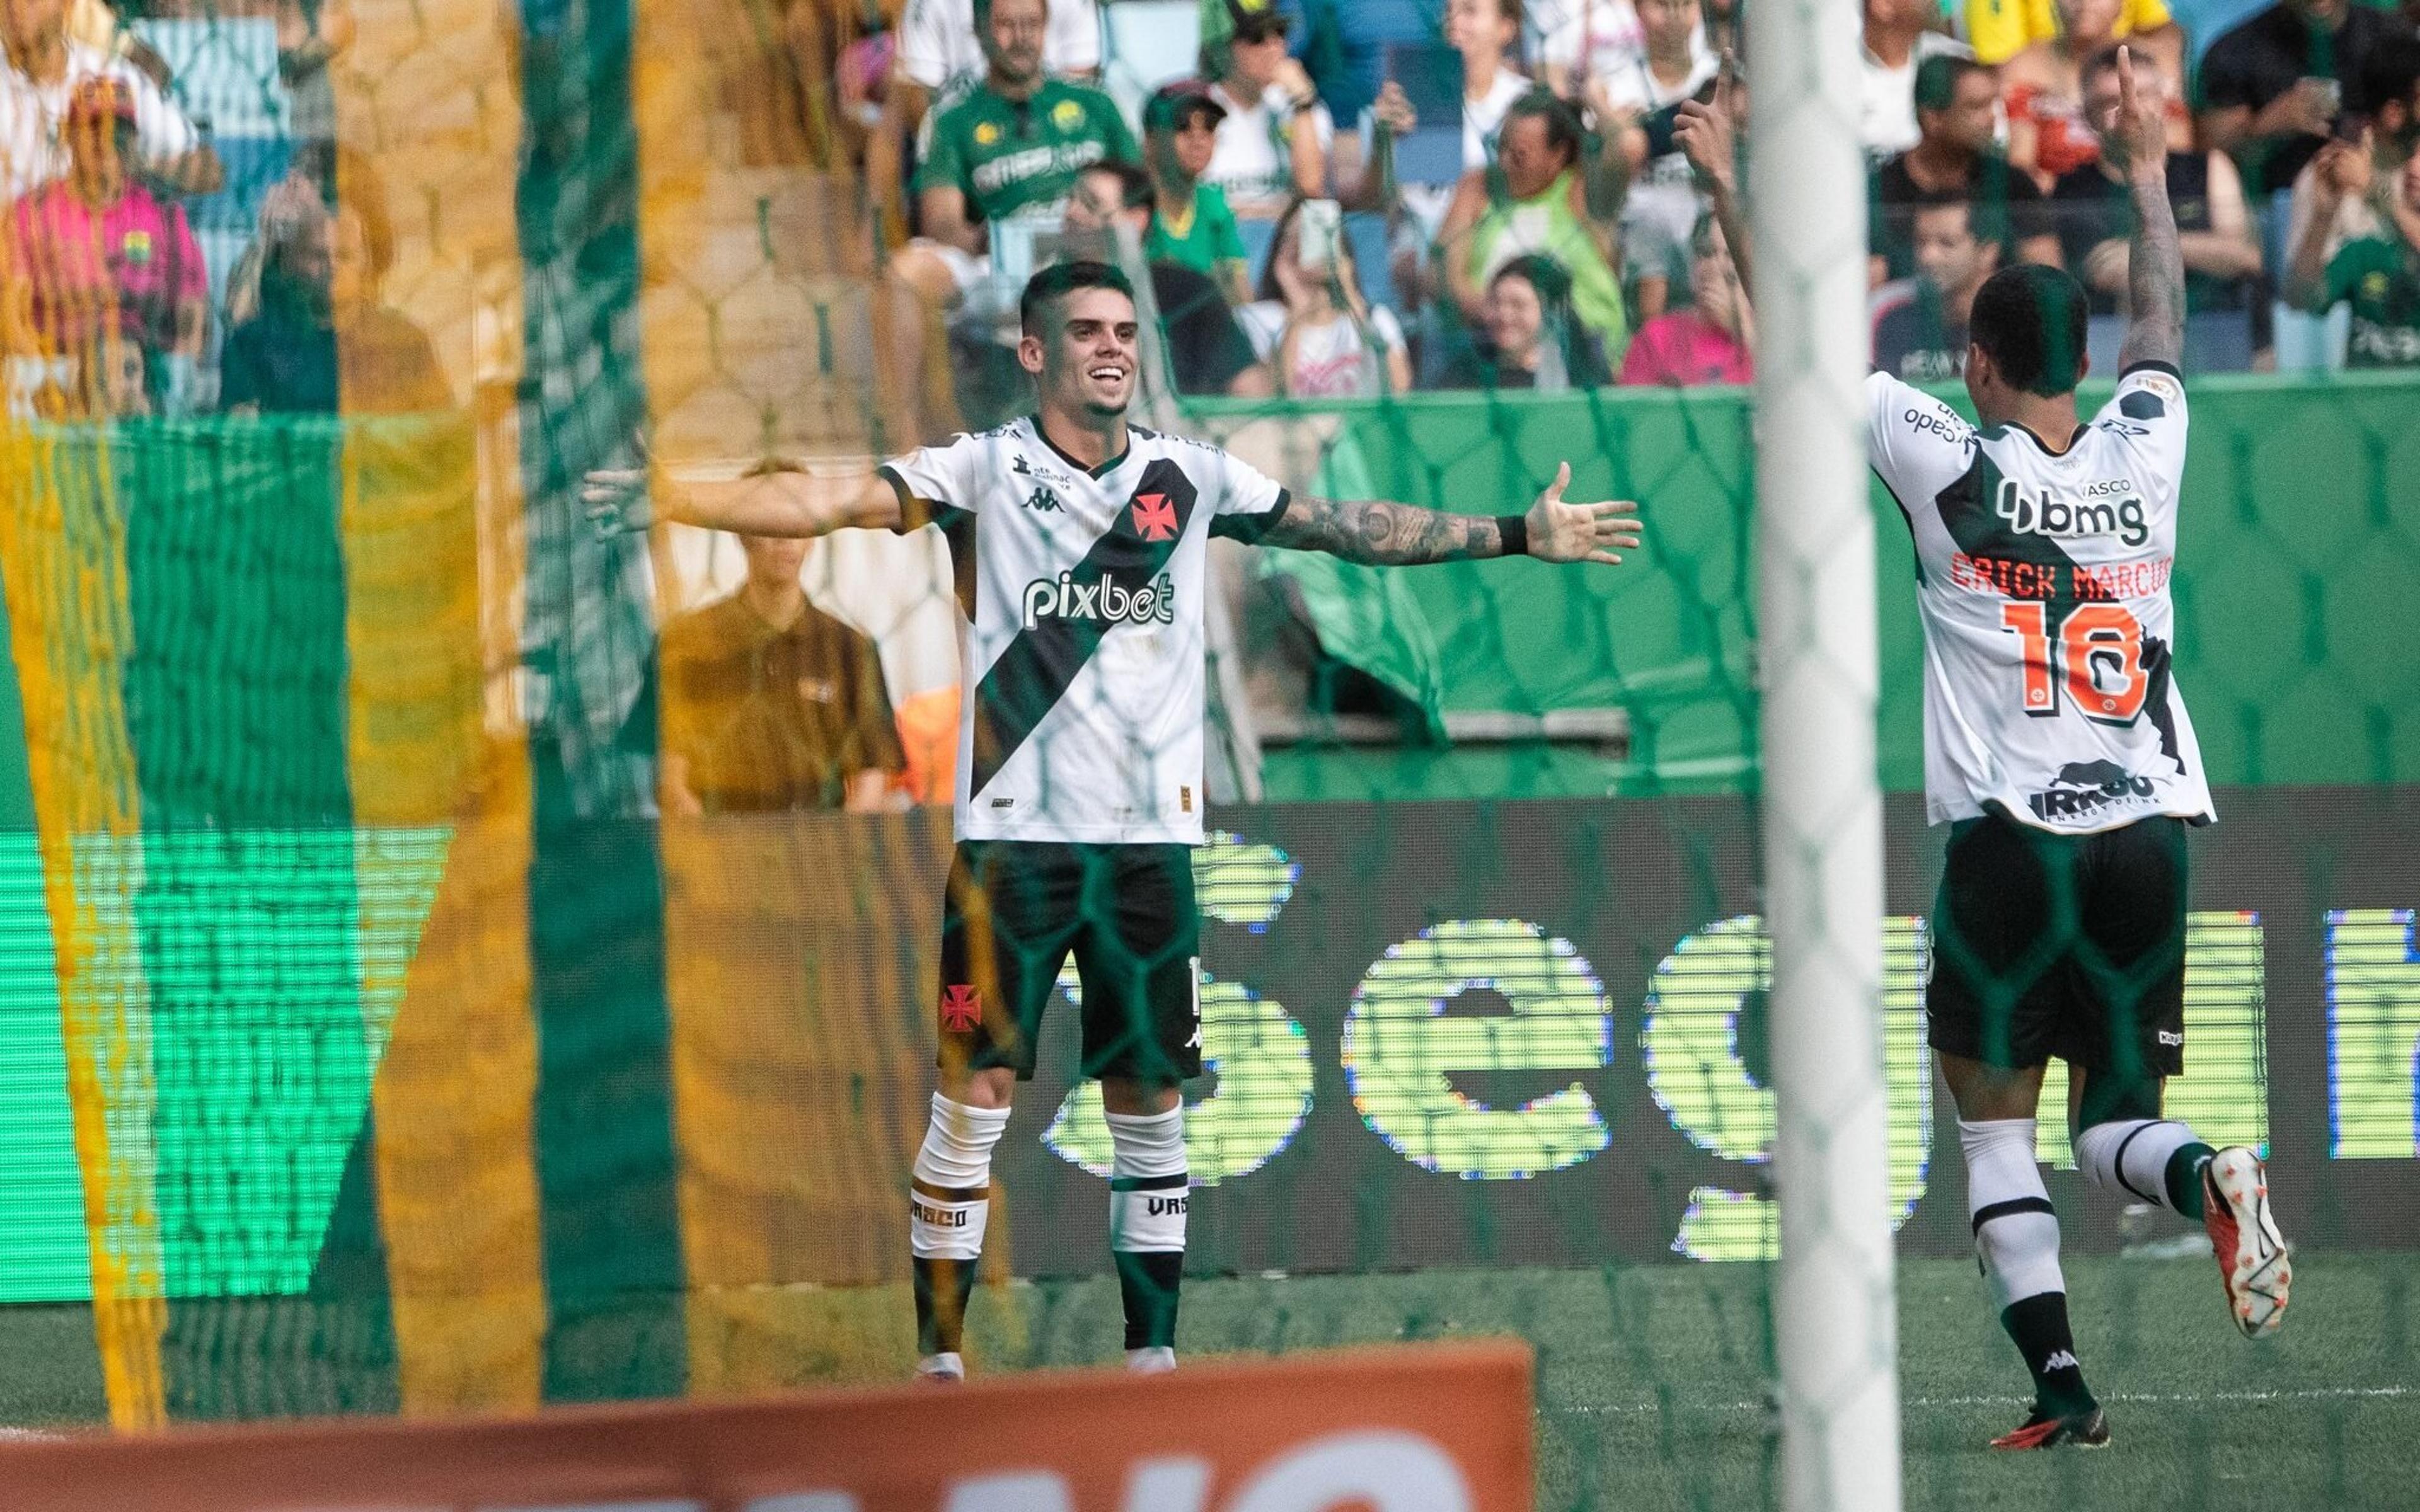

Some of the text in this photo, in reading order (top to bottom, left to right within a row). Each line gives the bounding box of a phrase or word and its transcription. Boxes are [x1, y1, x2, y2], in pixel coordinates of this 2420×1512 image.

[2040, 490, 2148, 547] bmg
[1023, 570, 1174, 630] pixbet
[1951, 552, 2056, 598] ERICK
[912, 1199, 967, 1227] ASCO
